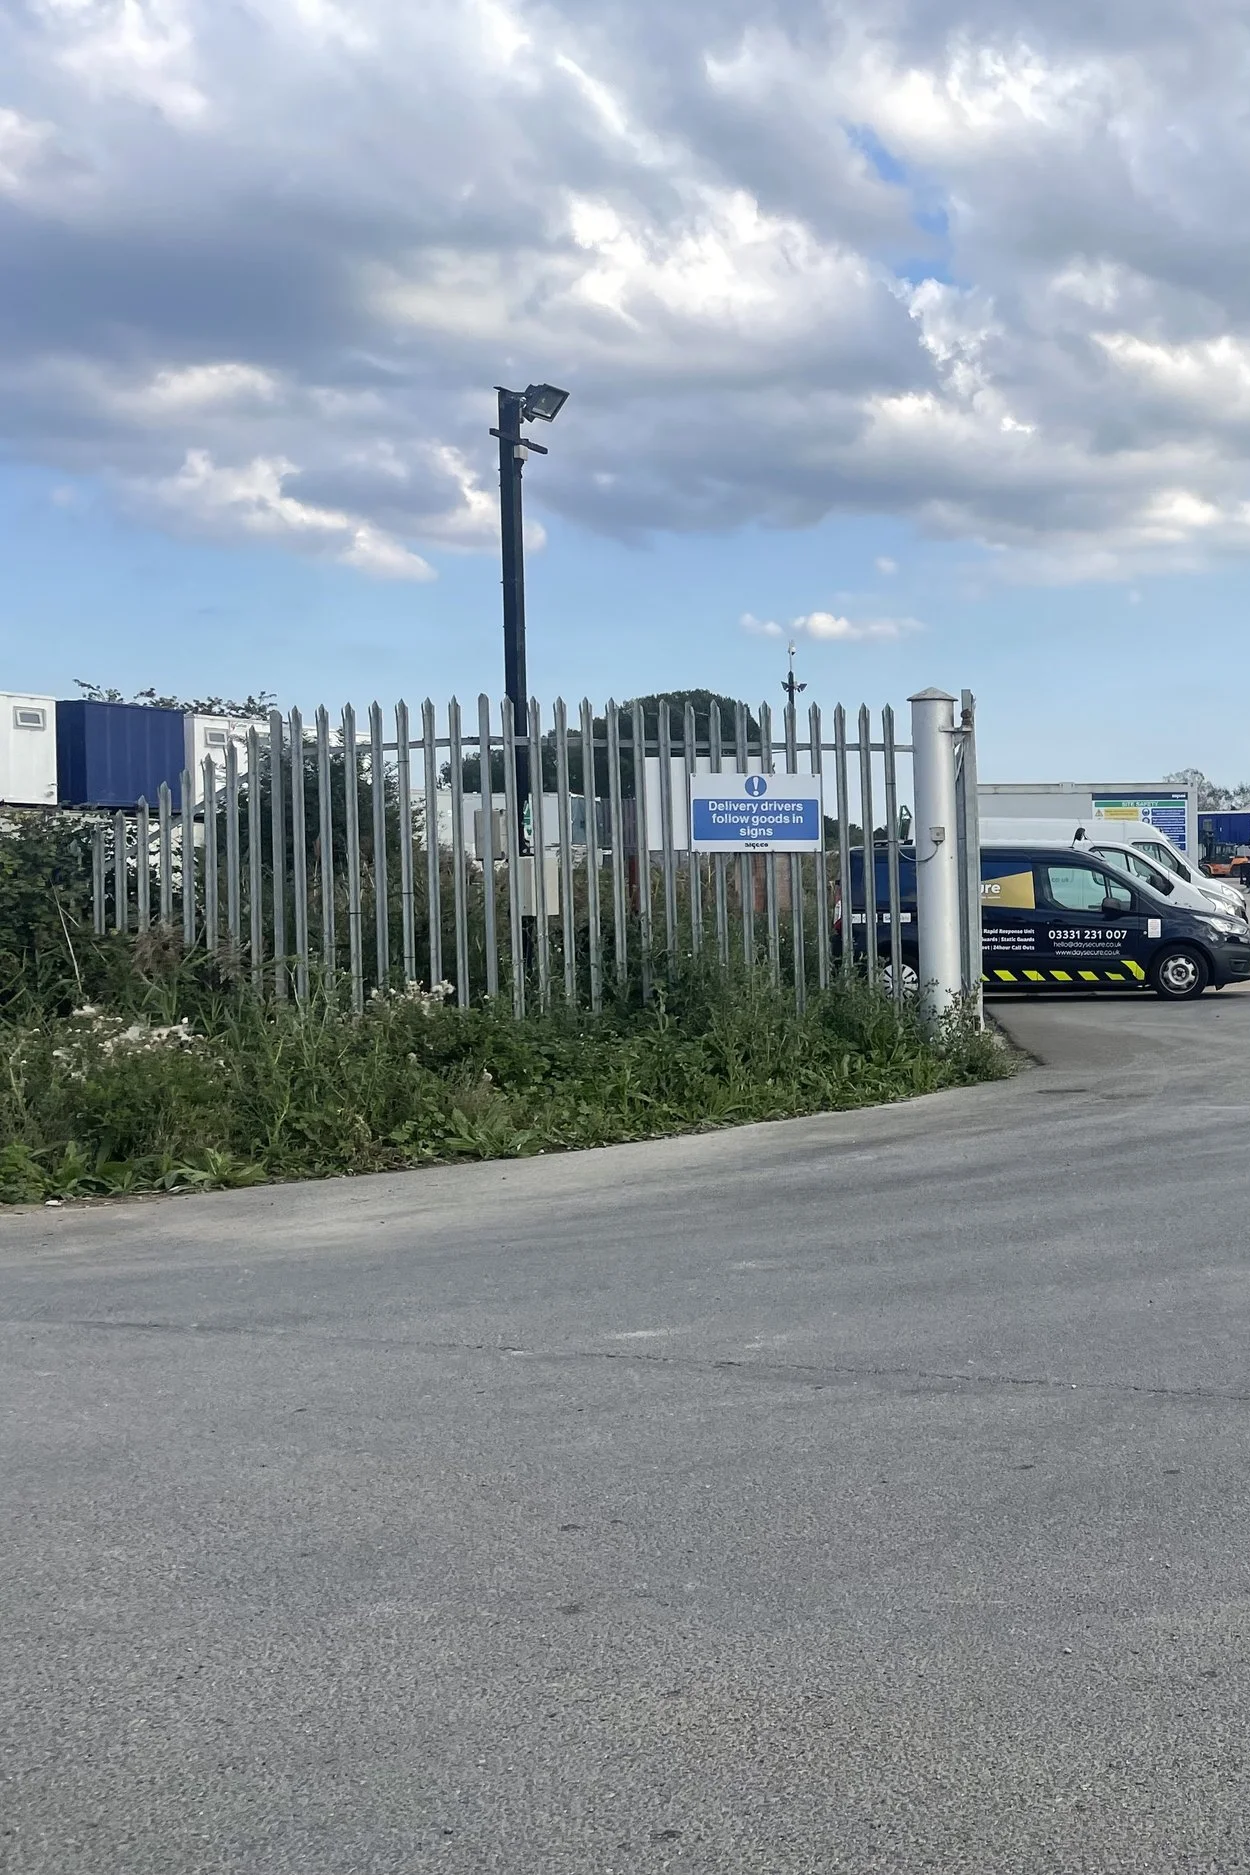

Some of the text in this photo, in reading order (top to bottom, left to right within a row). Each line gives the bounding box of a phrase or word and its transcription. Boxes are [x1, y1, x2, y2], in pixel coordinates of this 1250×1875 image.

[708, 801, 803, 813] Delivery drivers
[712, 814, 804, 826] follow goods in
[740, 826, 773, 838] signs
[1048, 930, 1128, 939] 03331 231 007
[1053, 941, 1122, 949] hello@daysecure.co.uk
